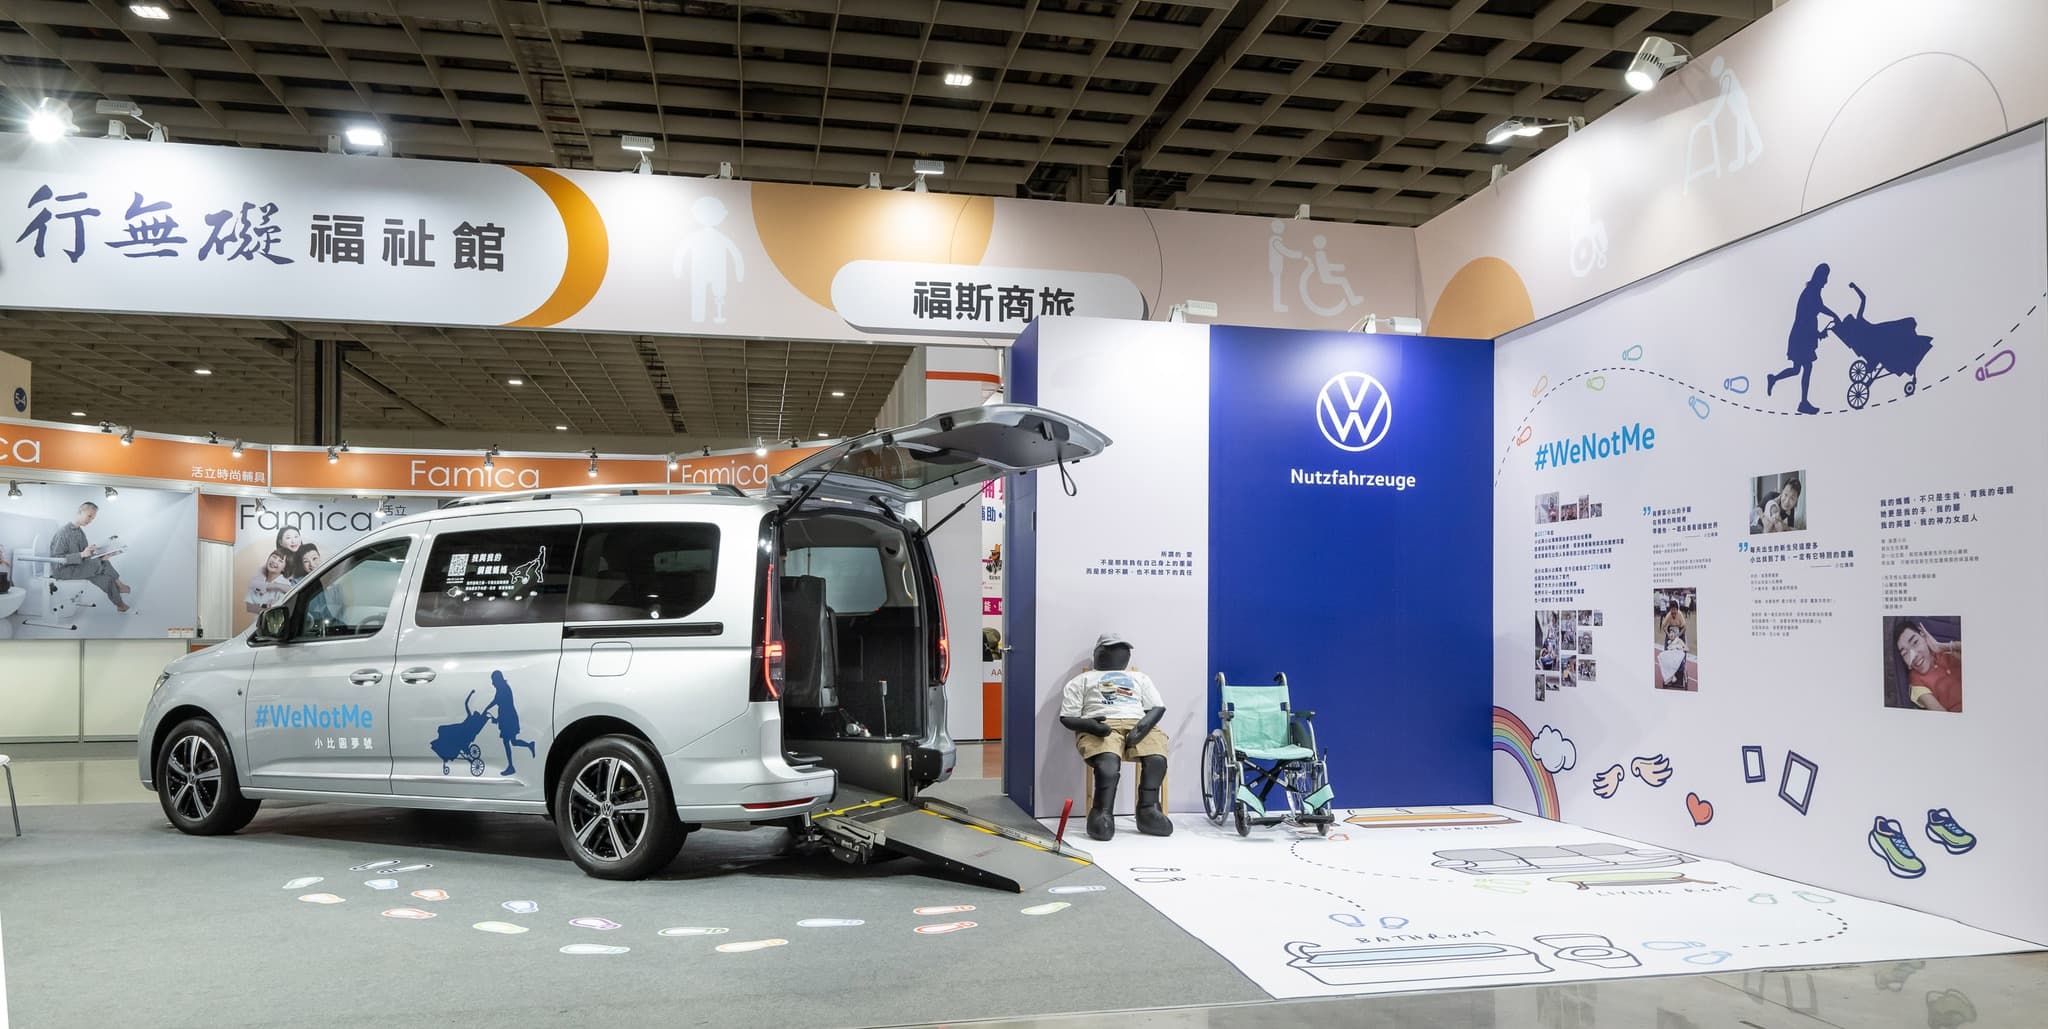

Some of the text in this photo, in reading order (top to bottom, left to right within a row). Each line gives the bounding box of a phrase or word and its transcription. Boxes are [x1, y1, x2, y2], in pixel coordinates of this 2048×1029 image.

[913, 281, 1075, 323] 福斯商旅
[1535, 422, 1655, 471] #WeNotMe
[191, 466, 265, 483] 活立時尚輔具
[411, 460, 540, 489] Famica
[682, 460, 769, 486] Famica
[1290, 468, 1416, 491] Nutzfahrzeuge
[240, 504, 372, 532] Famica
[255, 703, 373, 729] #WeNotMe
